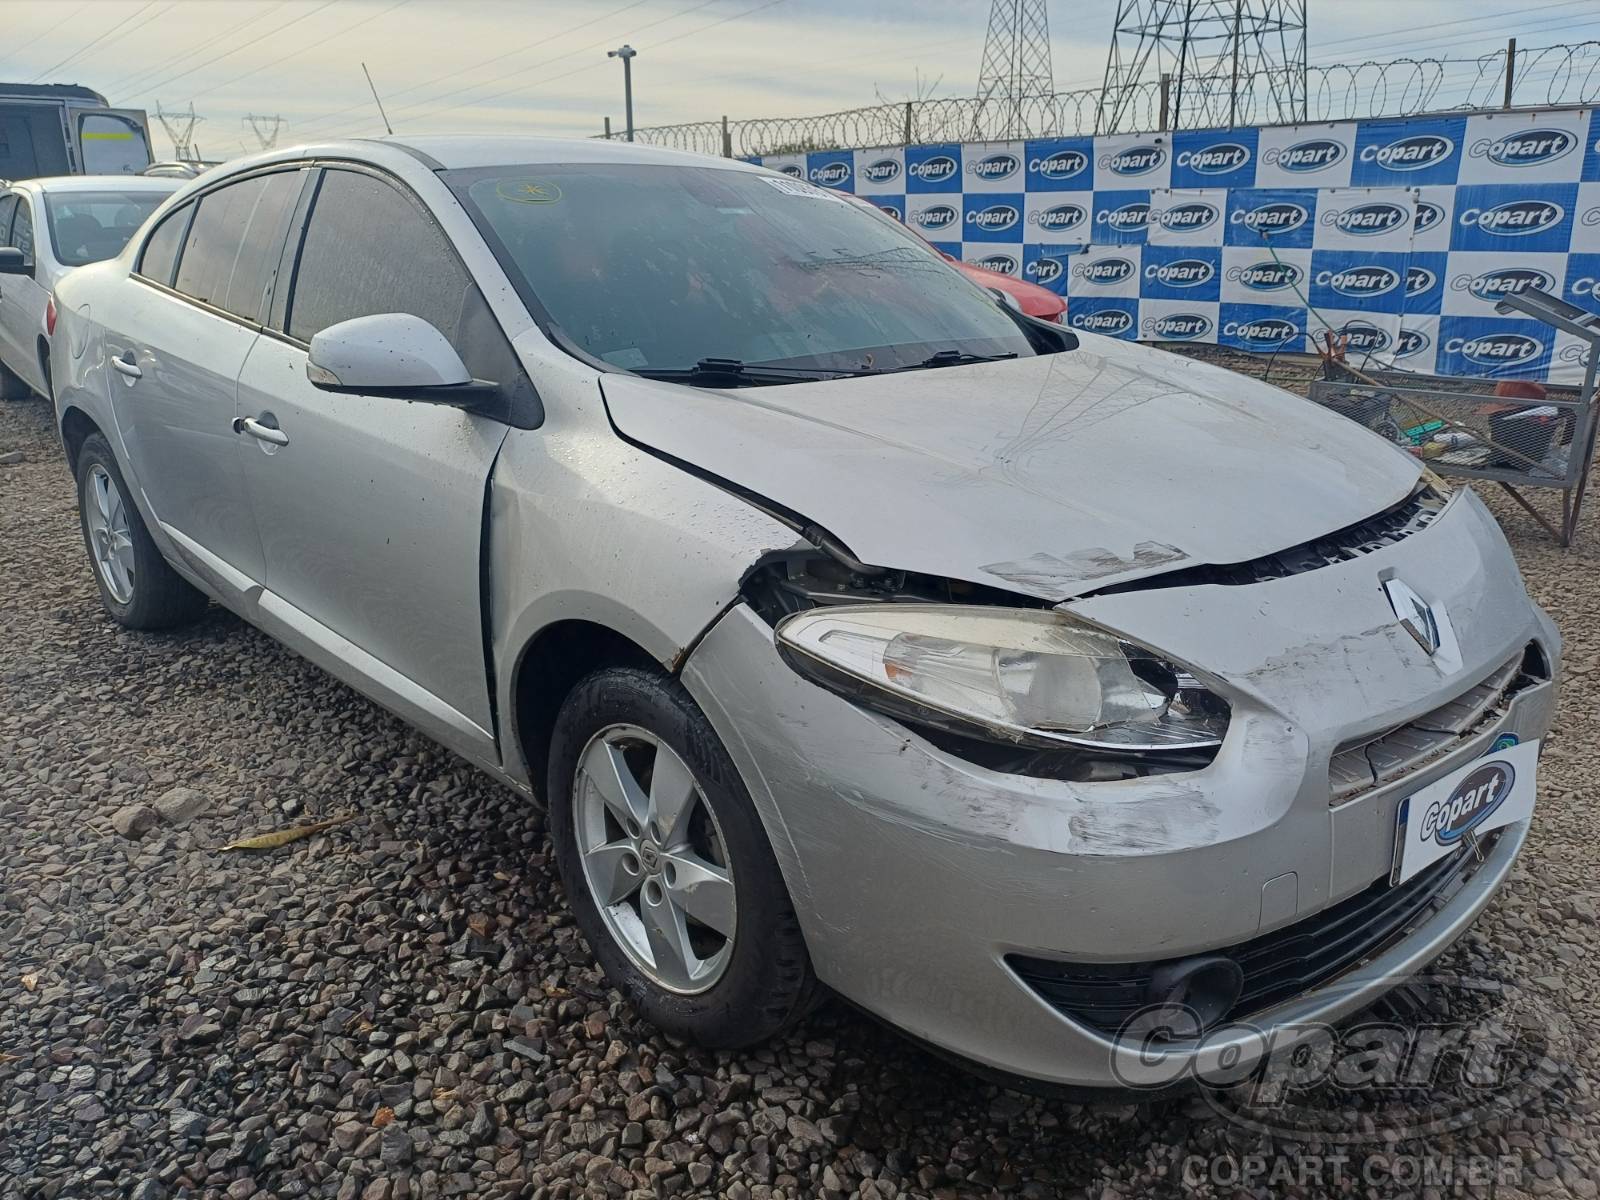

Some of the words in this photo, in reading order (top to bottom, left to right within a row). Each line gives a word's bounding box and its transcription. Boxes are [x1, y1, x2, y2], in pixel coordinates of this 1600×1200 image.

[1262, 143, 1336, 170] Copart
[1360, 140, 1444, 167] Copart
[1469, 134, 1564, 163] Copart
[909, 158, 952, 177] Copart
[966, 156, 1015, 177] Copart
[1029, 154, 1082, 175] Copart
[1098, 151, 1158, 173] Copart
[1176, 147, 1241, 172] Copart
[810, 166, 847, 182] Copart
[908, 206, 952, 226] Copart
[966, 207, 1014, 225] Copart
[1028, 207, 1080, 226] Copart
[1148, 208, 1210, 226] Copart
[1230, 207, 1299, 229] Copart
[1320, 208, 1400, 230] Copart
[1460, 205, 1555, 229] Copart
[1072, 262, 1128, 281] Copart
[1145, 264, 1207, 284] Copart
[1226, 266, 1296, 290] Copart
[1316, 271, 1394, 293] Copart
[1450, 274, 1541, 295] Copart
[1073, 313, 1127, 332] Copart
[1142, 316, 1204, 337] Copart
[1224, 322, 1294, 345] Copart
[1445, 337, 1530, 363] Copart
[1420, 772, 1499, 842] Copart
